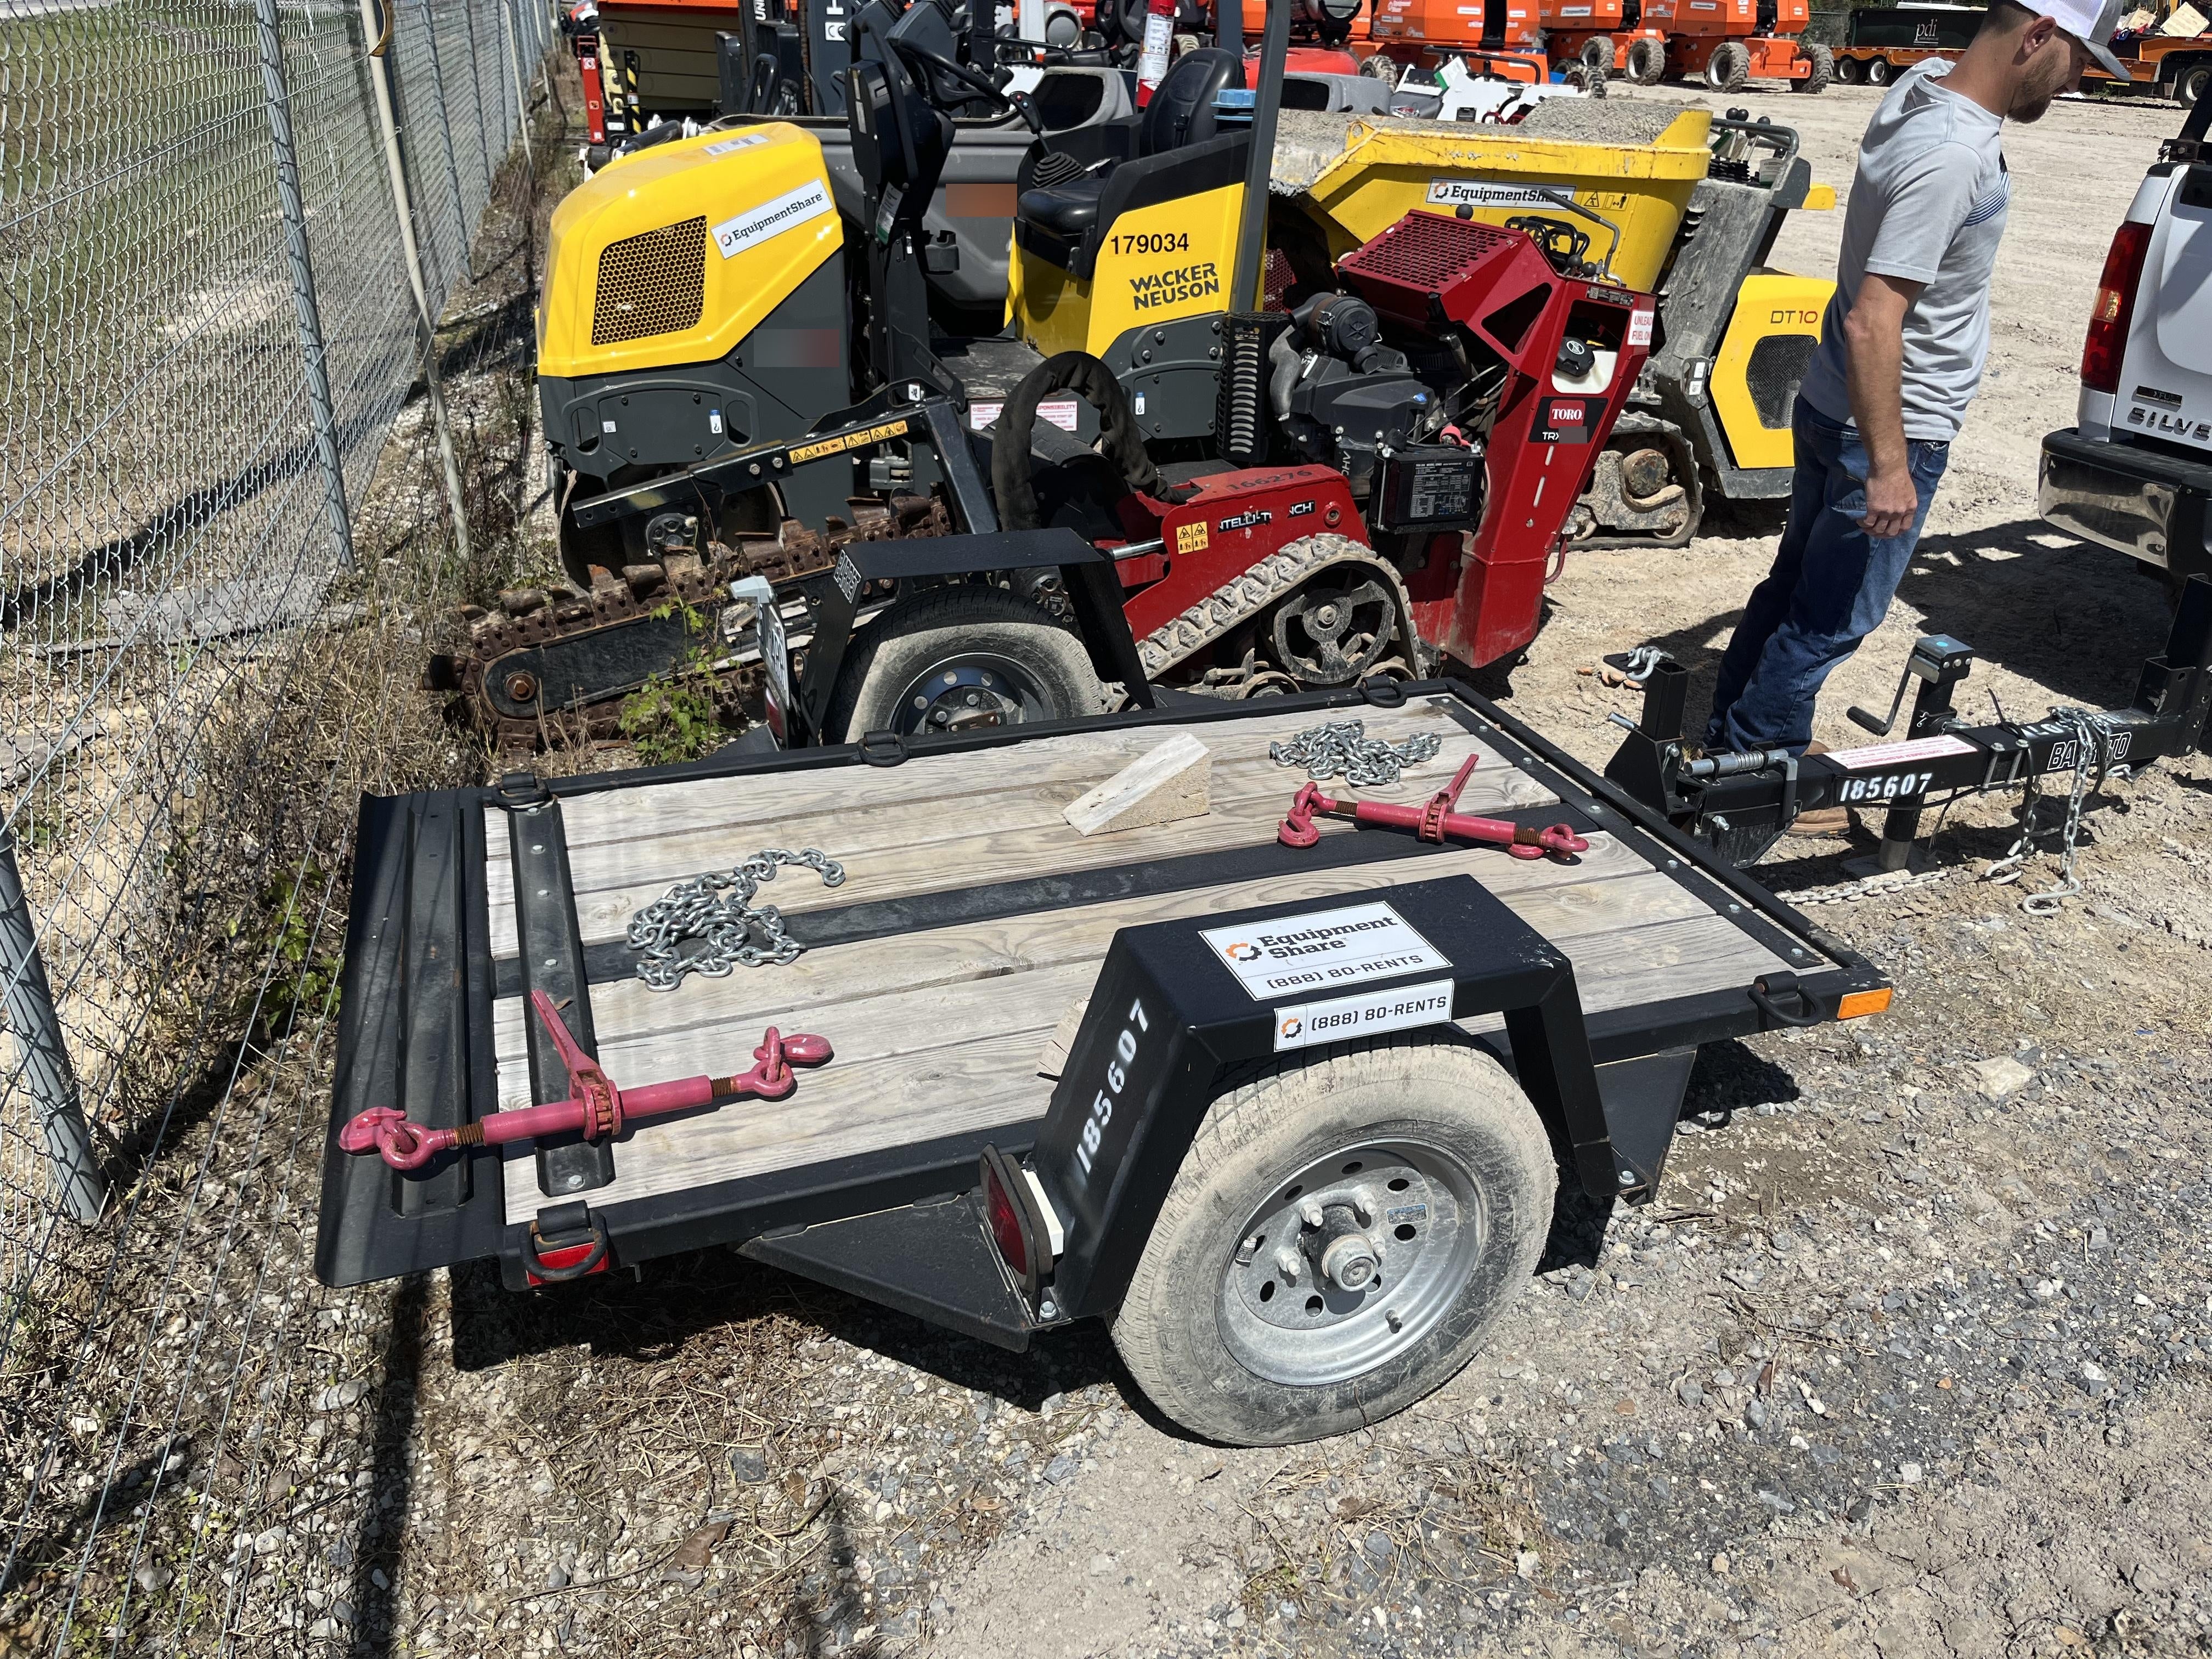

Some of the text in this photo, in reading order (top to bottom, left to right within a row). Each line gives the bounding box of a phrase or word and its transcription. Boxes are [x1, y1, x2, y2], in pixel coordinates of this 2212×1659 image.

[1914, 18, 1938, 41] pdi
[1451, 185, 1568, 204] EquipmentSh
[732, 192, 823, 242] EquipmentShare
[1110, 233, 1189, 255] 179034
[1130, 263, 1217, 292] WACKER
[1133, 278, 1220, 311] NEUSON
[1552, 409, 1583, 420] TORO
[1227, 470, 1313, 490] 166276
[2047, 731, 2132, 770] BATO
[1839, 773, 1932, 803] 185607
[1259, 915, 1398, 949] Equipment
[1268, 936, 1345, 960] Share
[1266, 954, 1424, 990] (888) 80-RENTS
[1311, 995, 1447, 1031] (888) 80-RENTS
[1077, 998, 1149, 1173] 185607
